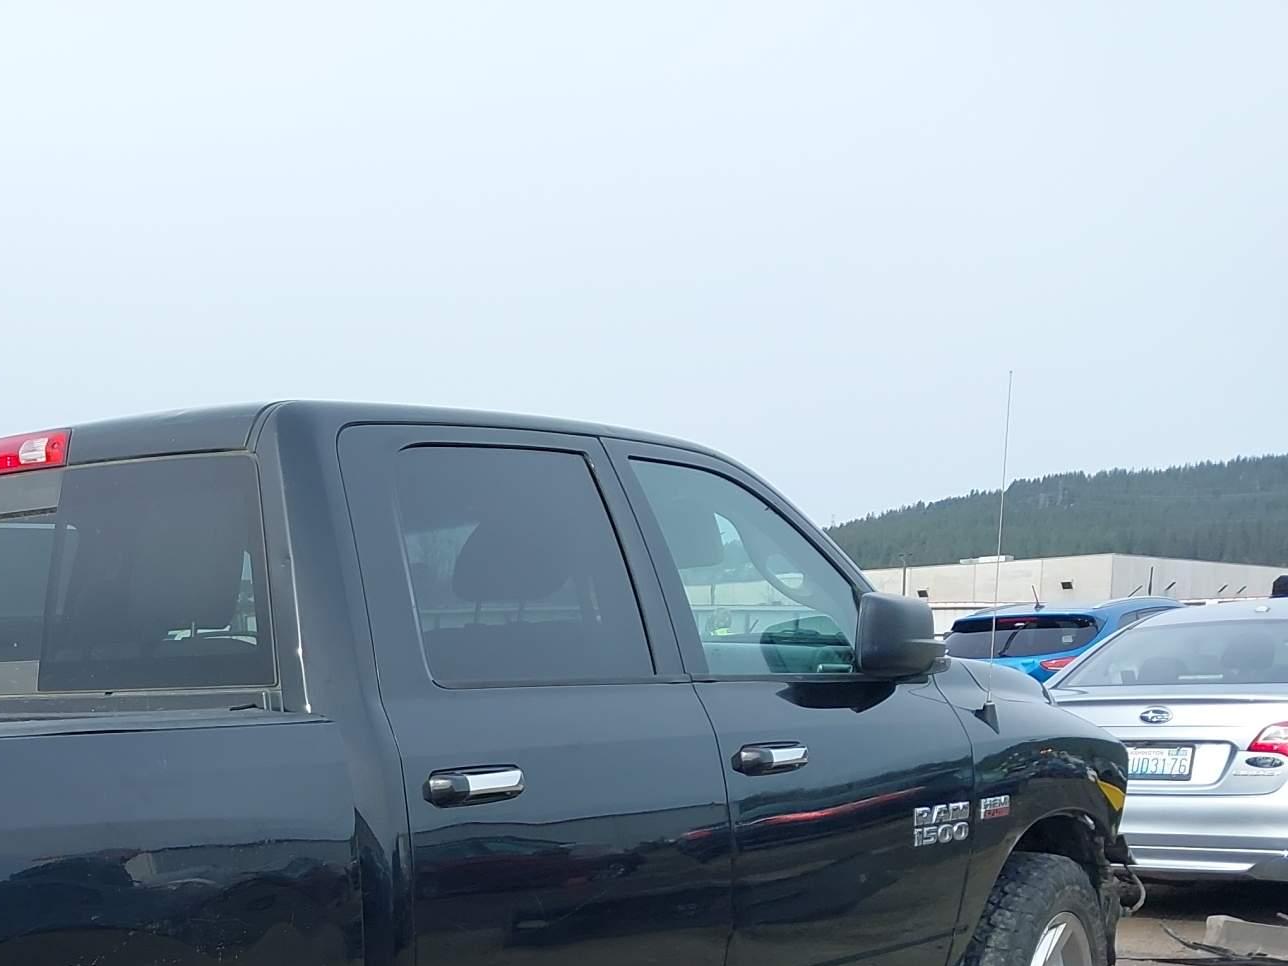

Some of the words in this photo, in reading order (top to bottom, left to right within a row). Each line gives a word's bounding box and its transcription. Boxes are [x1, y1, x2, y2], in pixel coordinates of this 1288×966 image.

[1129, 757, 1188, 774] UD3176
[914, 801, 970, 826] RAM
[914, 822, 969, 847] 1500
